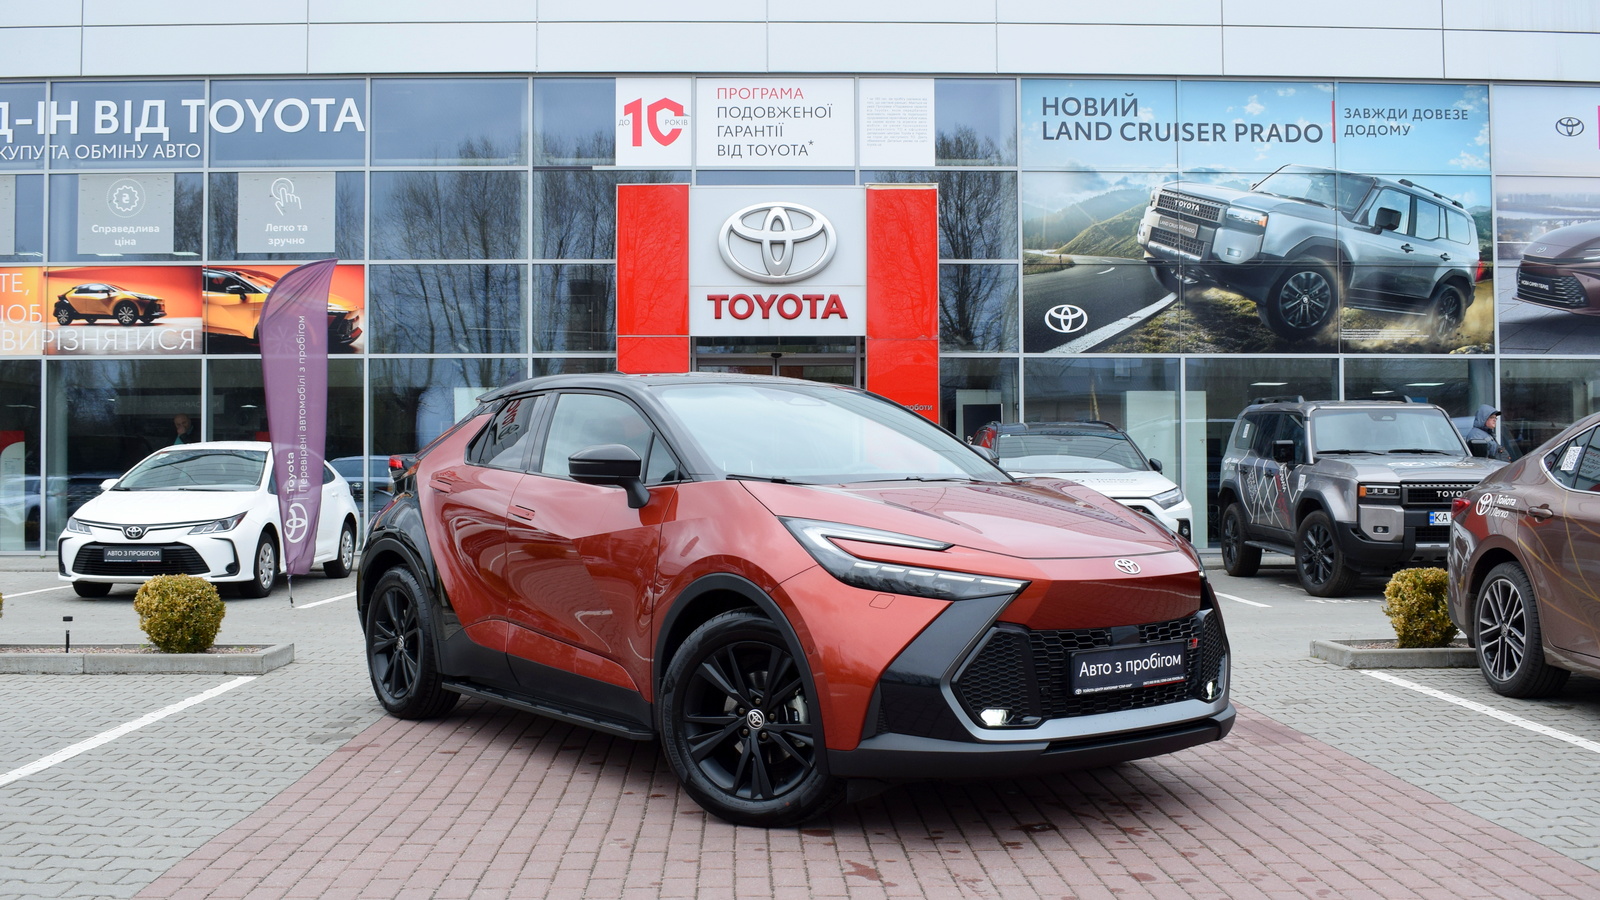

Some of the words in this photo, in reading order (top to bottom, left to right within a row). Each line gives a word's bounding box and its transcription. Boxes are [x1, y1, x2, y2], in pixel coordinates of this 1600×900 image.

[717, 87, 803, 99] ПРОГРАМА
[717, 103, 832, 120] ПОДОВЖЕНОЇ
[1042, 92, 1138, 117] НОВИЙ
[95, 100, 169, 141] ВІД
[181, 98, 365, 133] TOYOTA
[624, 97, 684, 146] 10
[1344, 107, 1408, 121] ЗАВЖДИ
[1412, 108, 1468, 121] ДОВЕЗЕ
[717, 122, 784, 138] ГАРАНТІЇ
[1042, 121, 1112, 141] LAND
[1120, 122, 1227, 142] CRUISER
[1235, 123, 1323, 143] PRADO
[1344, 124, 1411, 138] ДОДОМУ
[49, 145, 69, 159] ТА
[75, 144, 148, 159] ОБМІНУ
[153, 143, 201, 158] АВТО
[717, 144, 742, 158] ВІД
[1174, 200, 1200, 211] TOYOTA
[91, 224, 160, 235] Справедлива
[265, 223, 295, 233] Легко
[296, 224, 308, 233] та
[114, 237, 136, 248] ціна
[268, 237, 305, 247] зручно
[707, 294, 848, 319] TOYOTA
[2, 328, 195, 351] ВИРІЗНЯТИСЯ
[296, 315, 307, 364] пробігом
[297, 375, 307, 432] автомобілі
[298, 434, 310, 492] Перевірені
[286, 452, 297, 494] Toyota
[1497, 494, 1517, 506] Тойота
[1491, 507, 1509, 518] Легко
[1079, 661, 1111, 677] Авто
[1115, 663, 1122, 674] з
[1125, 652, 1181, 675] пробігом
